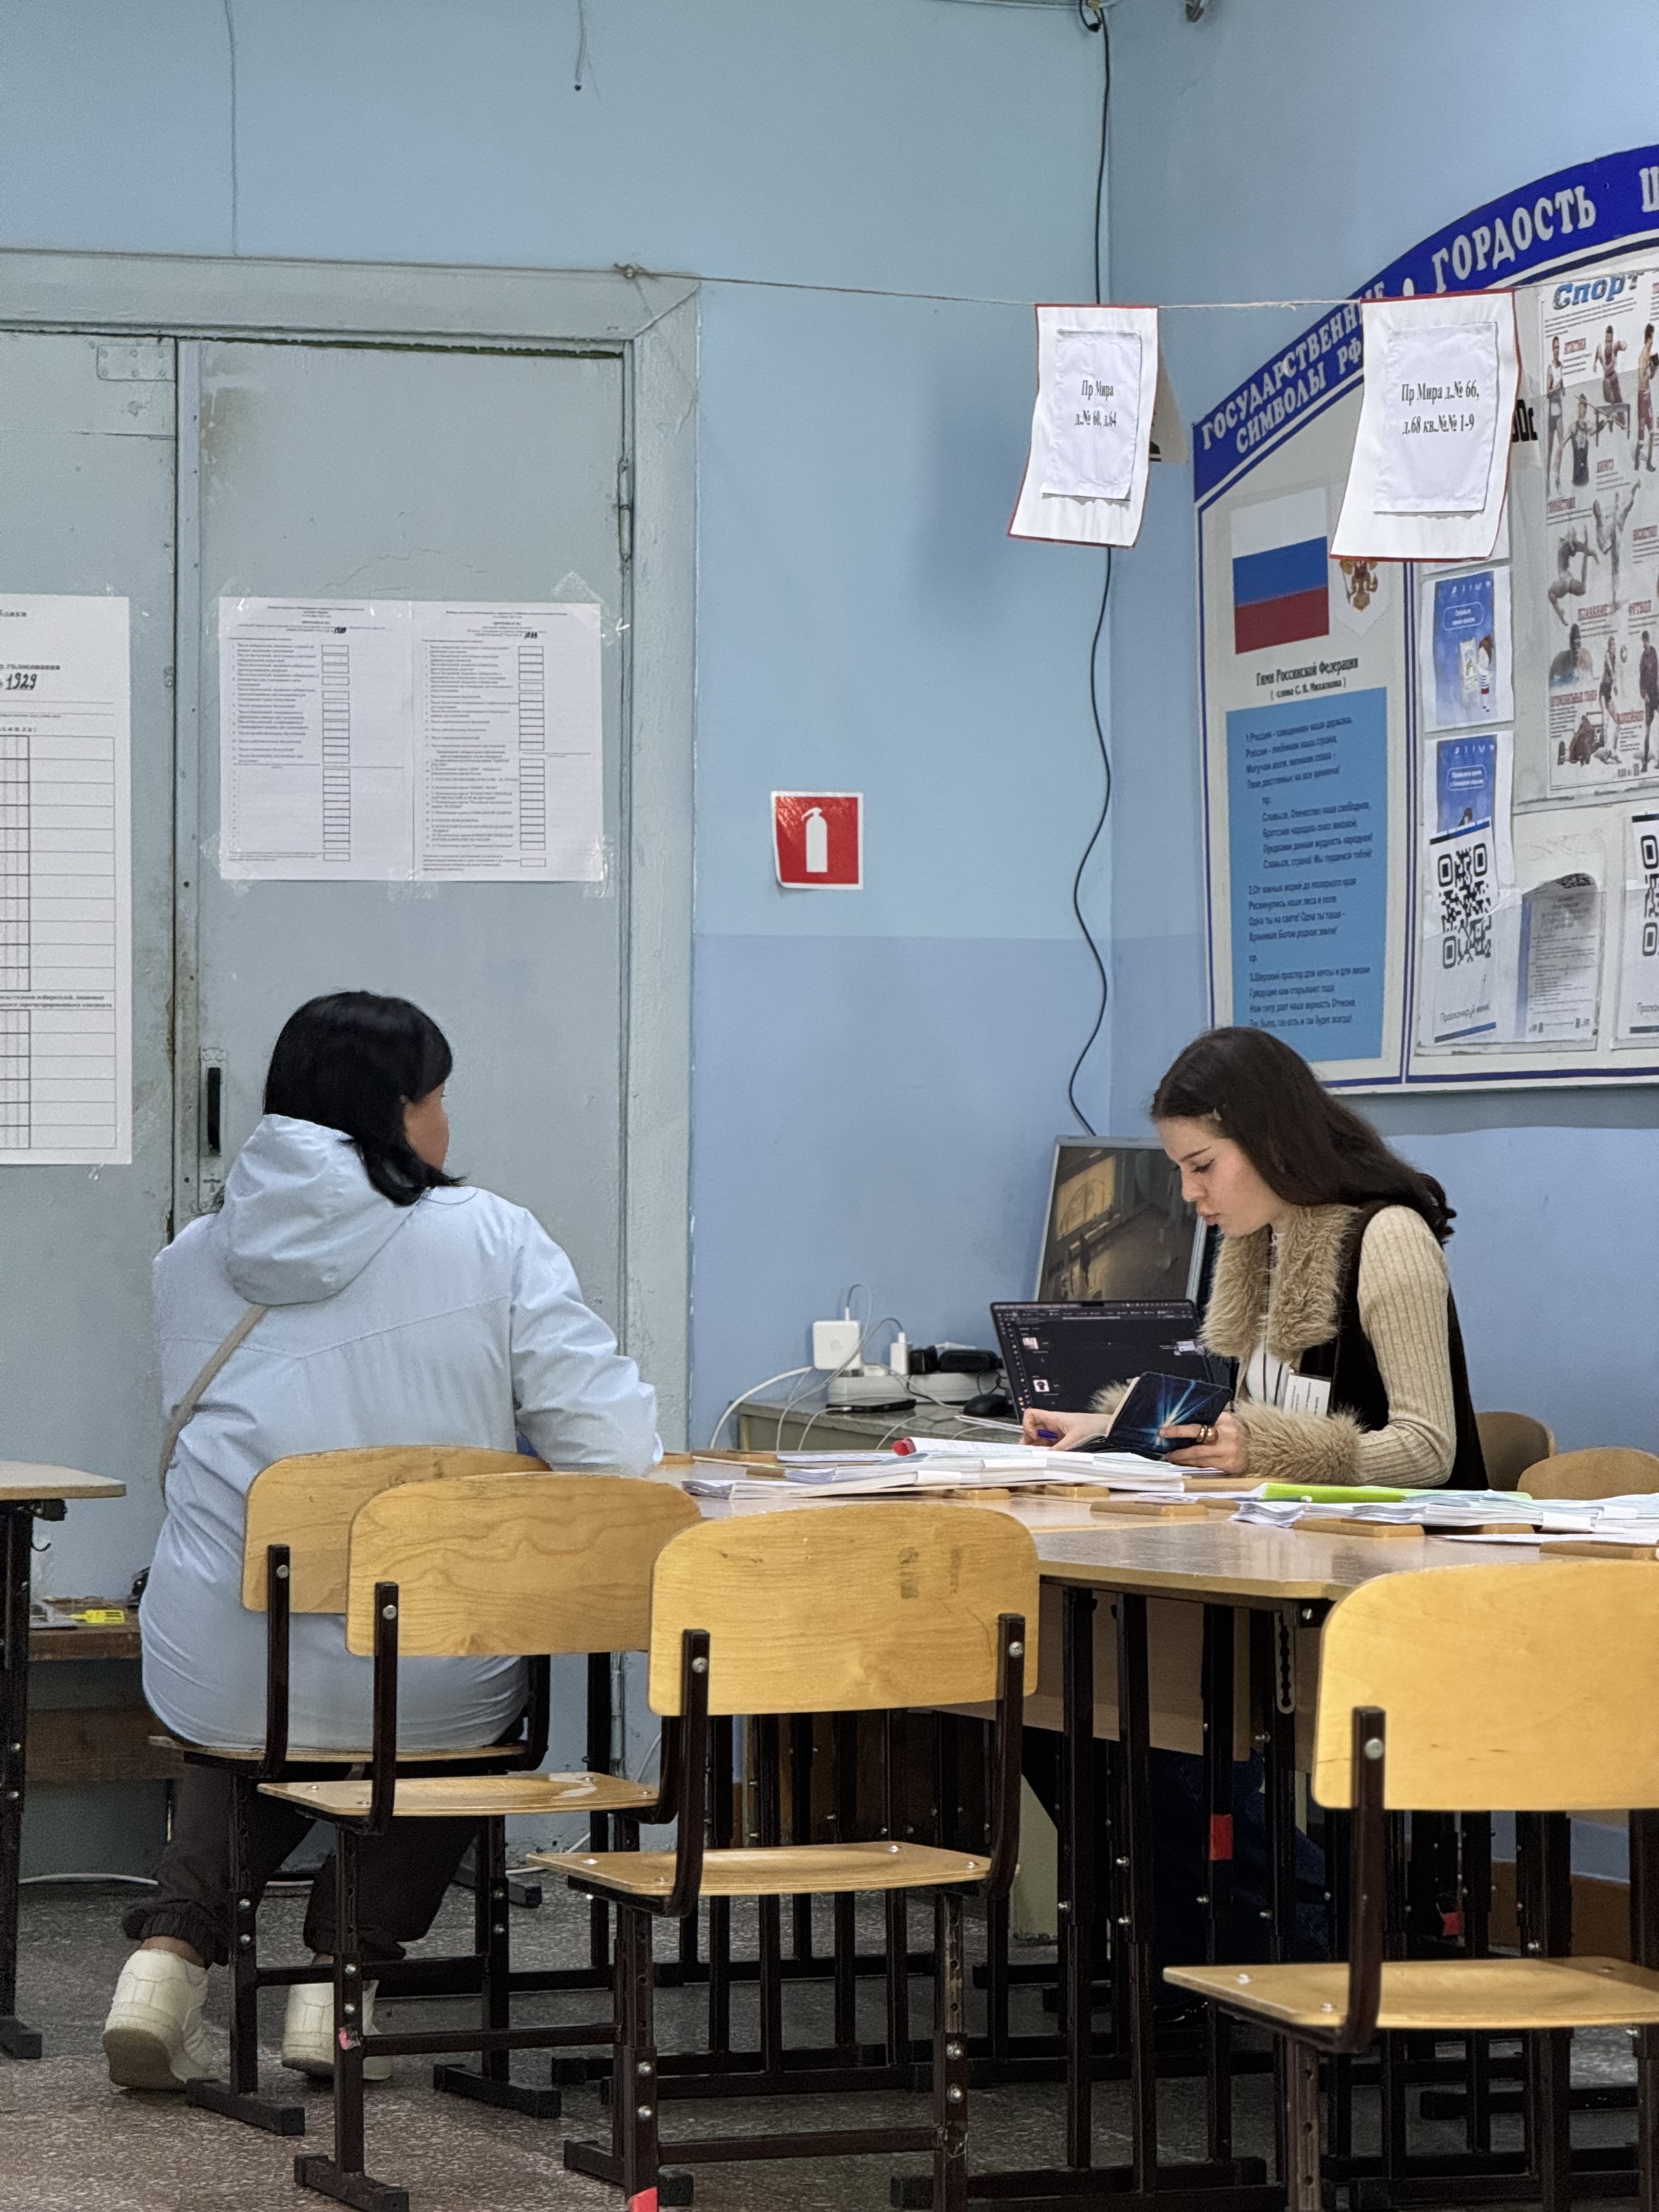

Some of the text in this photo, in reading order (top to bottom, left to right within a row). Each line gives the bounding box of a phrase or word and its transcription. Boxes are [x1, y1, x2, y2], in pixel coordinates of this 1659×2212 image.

[1432, 185, 1596, 294] ГОРДОСТЬ
[1553, 272, 1644, 310] Спорт
[1081, 380, 1114, 401] Пр Мира
[1236, 337, 1362, 454] СИМВОЛЫ РФ
[1401, 383, 1414, 406] Пр
[1417, 383, 1442, 405] Мира
[1465, 379, 1480, 402] 66,
[1460, 413, 1475, 432] 1-9
[5, 673, 37, 690] 1929
